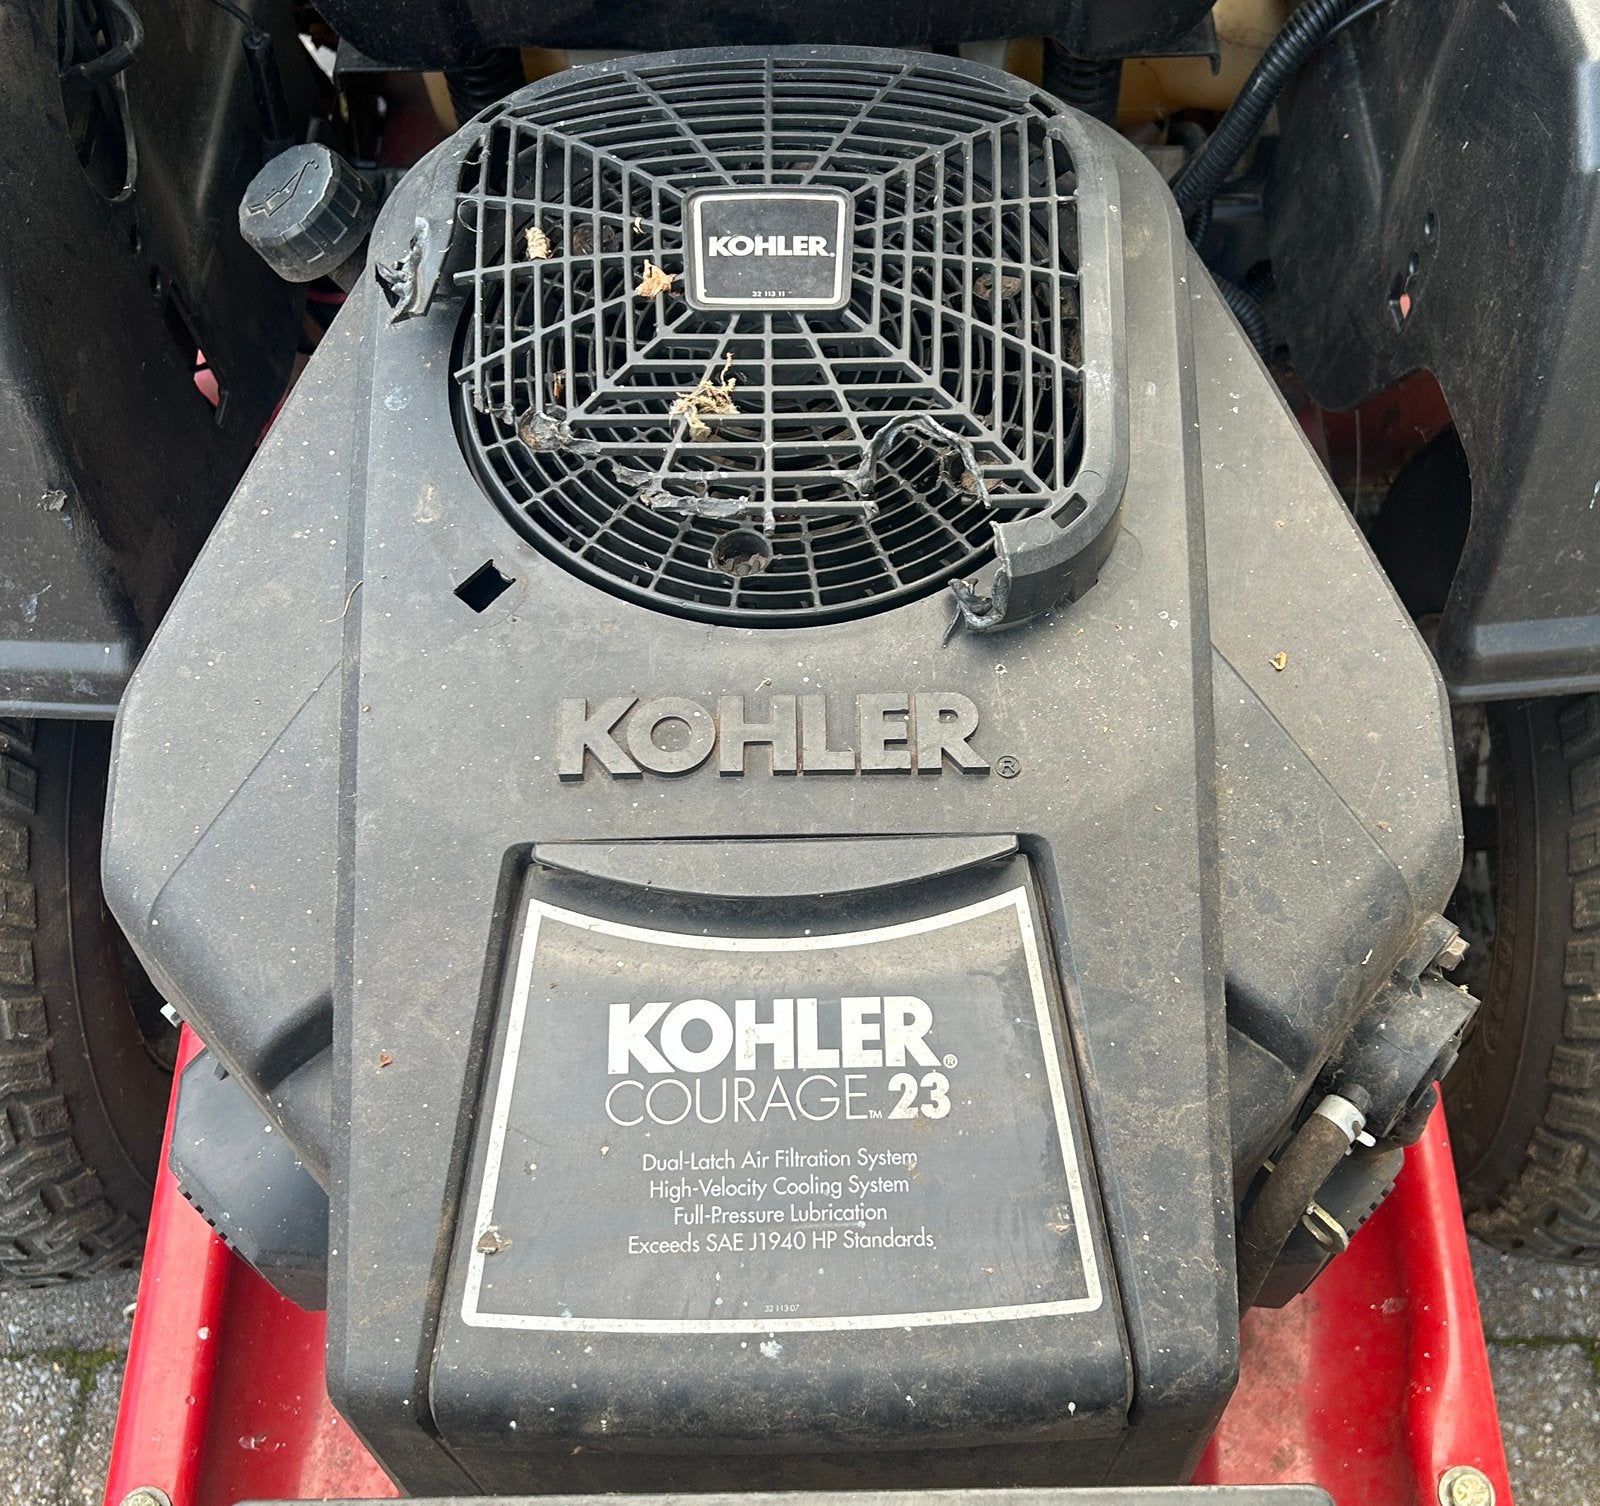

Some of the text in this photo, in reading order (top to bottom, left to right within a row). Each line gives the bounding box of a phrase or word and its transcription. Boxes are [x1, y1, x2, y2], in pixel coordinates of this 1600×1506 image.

[887, 1072, 951, 1120] 23
[642, 1147, 918, 1172] Dual-Latch Air Filtration System
[649, 1174, 910, 1203] High-Velocity Cooling System
[674, 1201, 888, 1225] Full-Pressure Lubrication
[628, 1232, 700, 1254] Exceeds
[706, 1232, 744, 1252] SAE
[749, 1231, 807, 1251] J1940
[812, 1231, 838, 1249] HP
